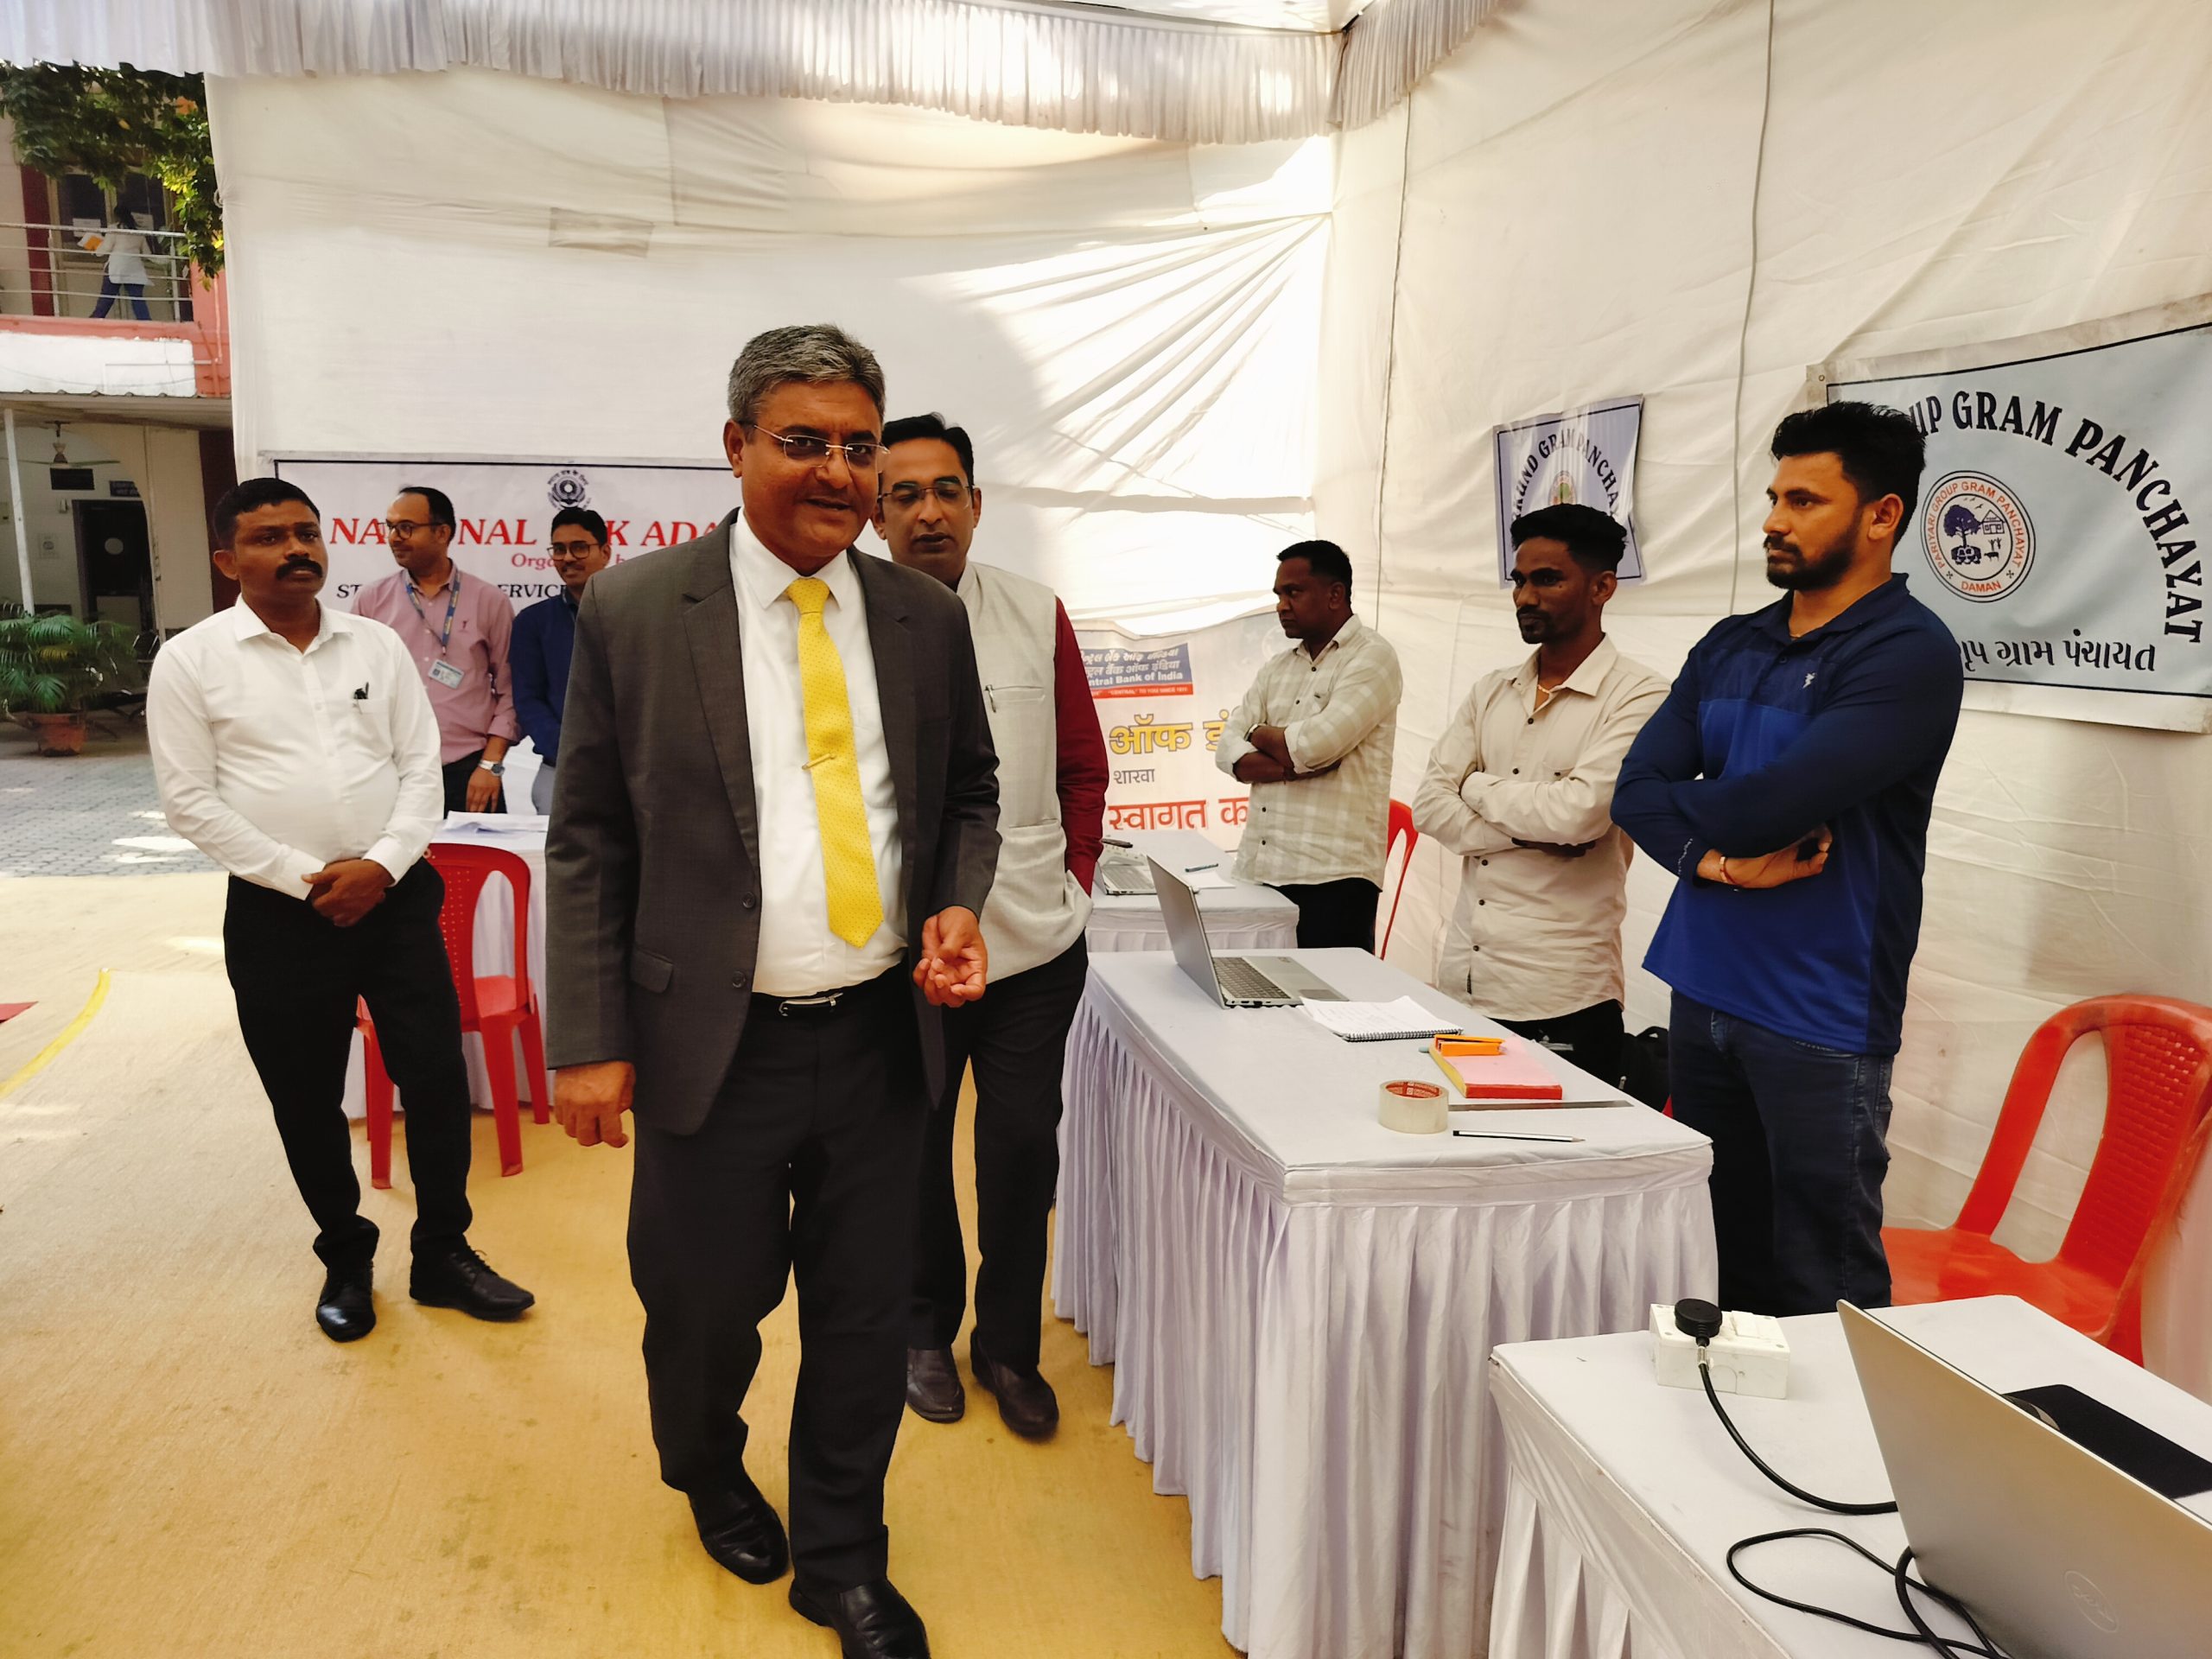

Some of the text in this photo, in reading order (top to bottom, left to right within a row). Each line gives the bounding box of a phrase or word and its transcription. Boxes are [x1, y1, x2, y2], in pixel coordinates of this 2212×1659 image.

[1538, 428, 1576, 459] GRAM
[1927, 480, 2025, 569] PARIYARI GROUP GRAM PANCHAYAT
[1952, 391, 2063, 446] GRAM
[2064, 418, 2202, 643] PANCHAYAT
[1961, 581, 2002, 593] DAMAN
[1994, 640, 2055, 666] ગ્રામ
[2063, 628, 2156, 671] પંચાયત
[1116, 673, 1142, 684] Bank
[1144, 672, 1155, 681] of
[1158, 671, 1183, 681] India
[1109, 713, 1193, 754] ऑफ
[1108, 798, 1206, 830] स्वागत
